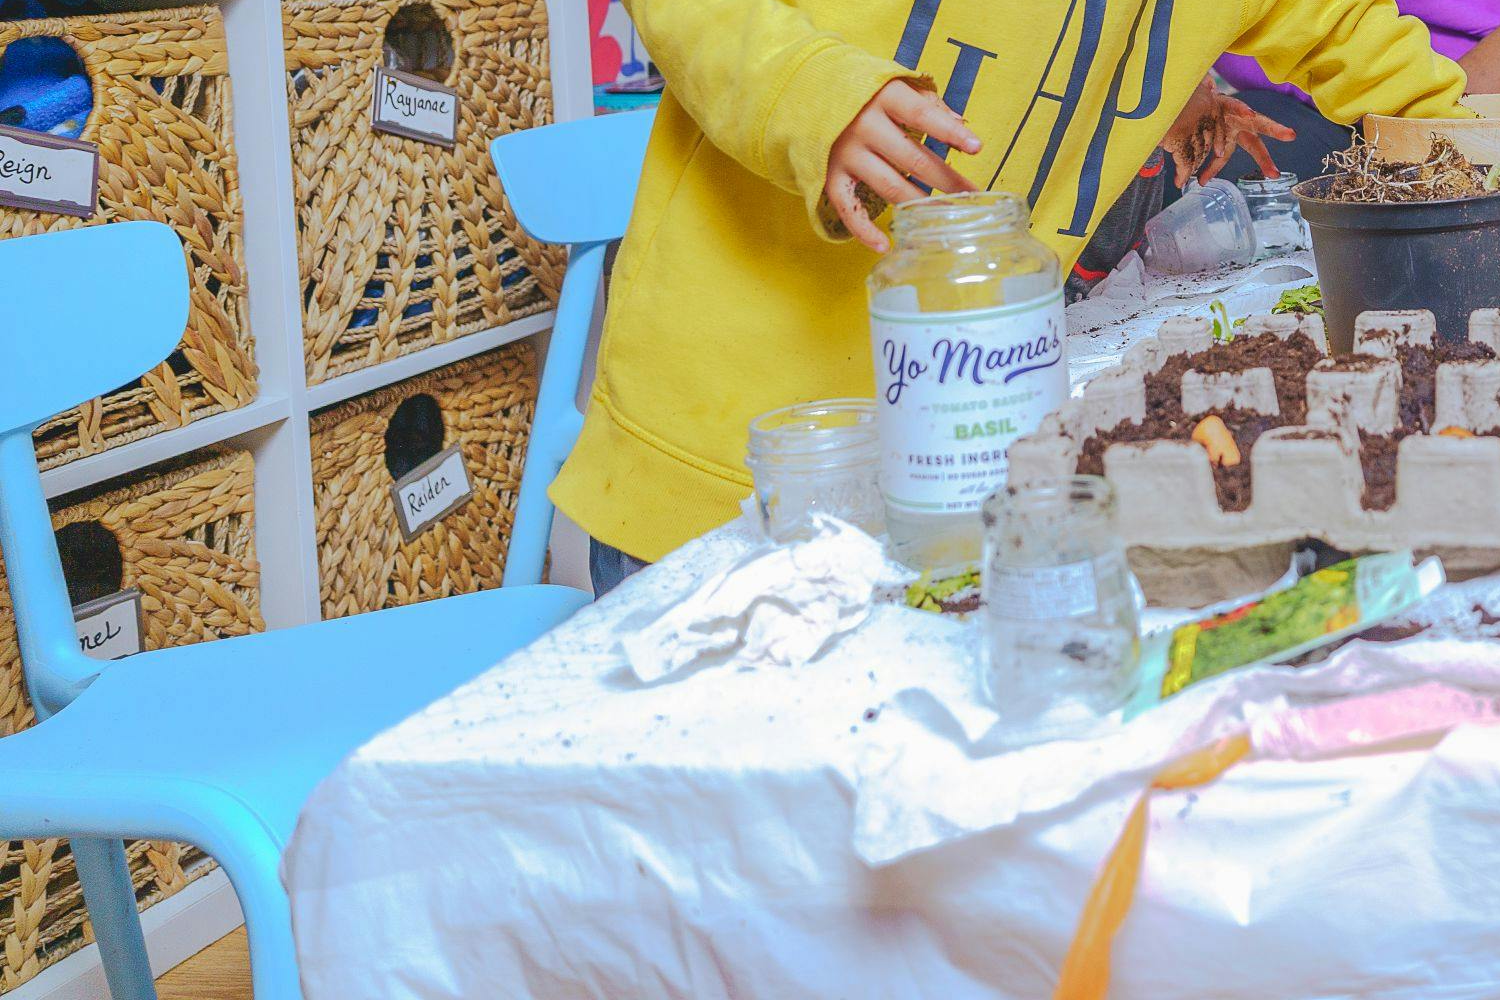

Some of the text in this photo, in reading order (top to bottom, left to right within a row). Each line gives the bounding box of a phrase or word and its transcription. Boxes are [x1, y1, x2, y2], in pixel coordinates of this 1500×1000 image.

[884, 318, 1063, 405] Yo Mama's
[931, 399, 989, 414] TOMATO
[954, 417, 1018, 441] BASIL
[908, 453, 955, 466] FRESH
[408, 476, 451, 517] Raiden
